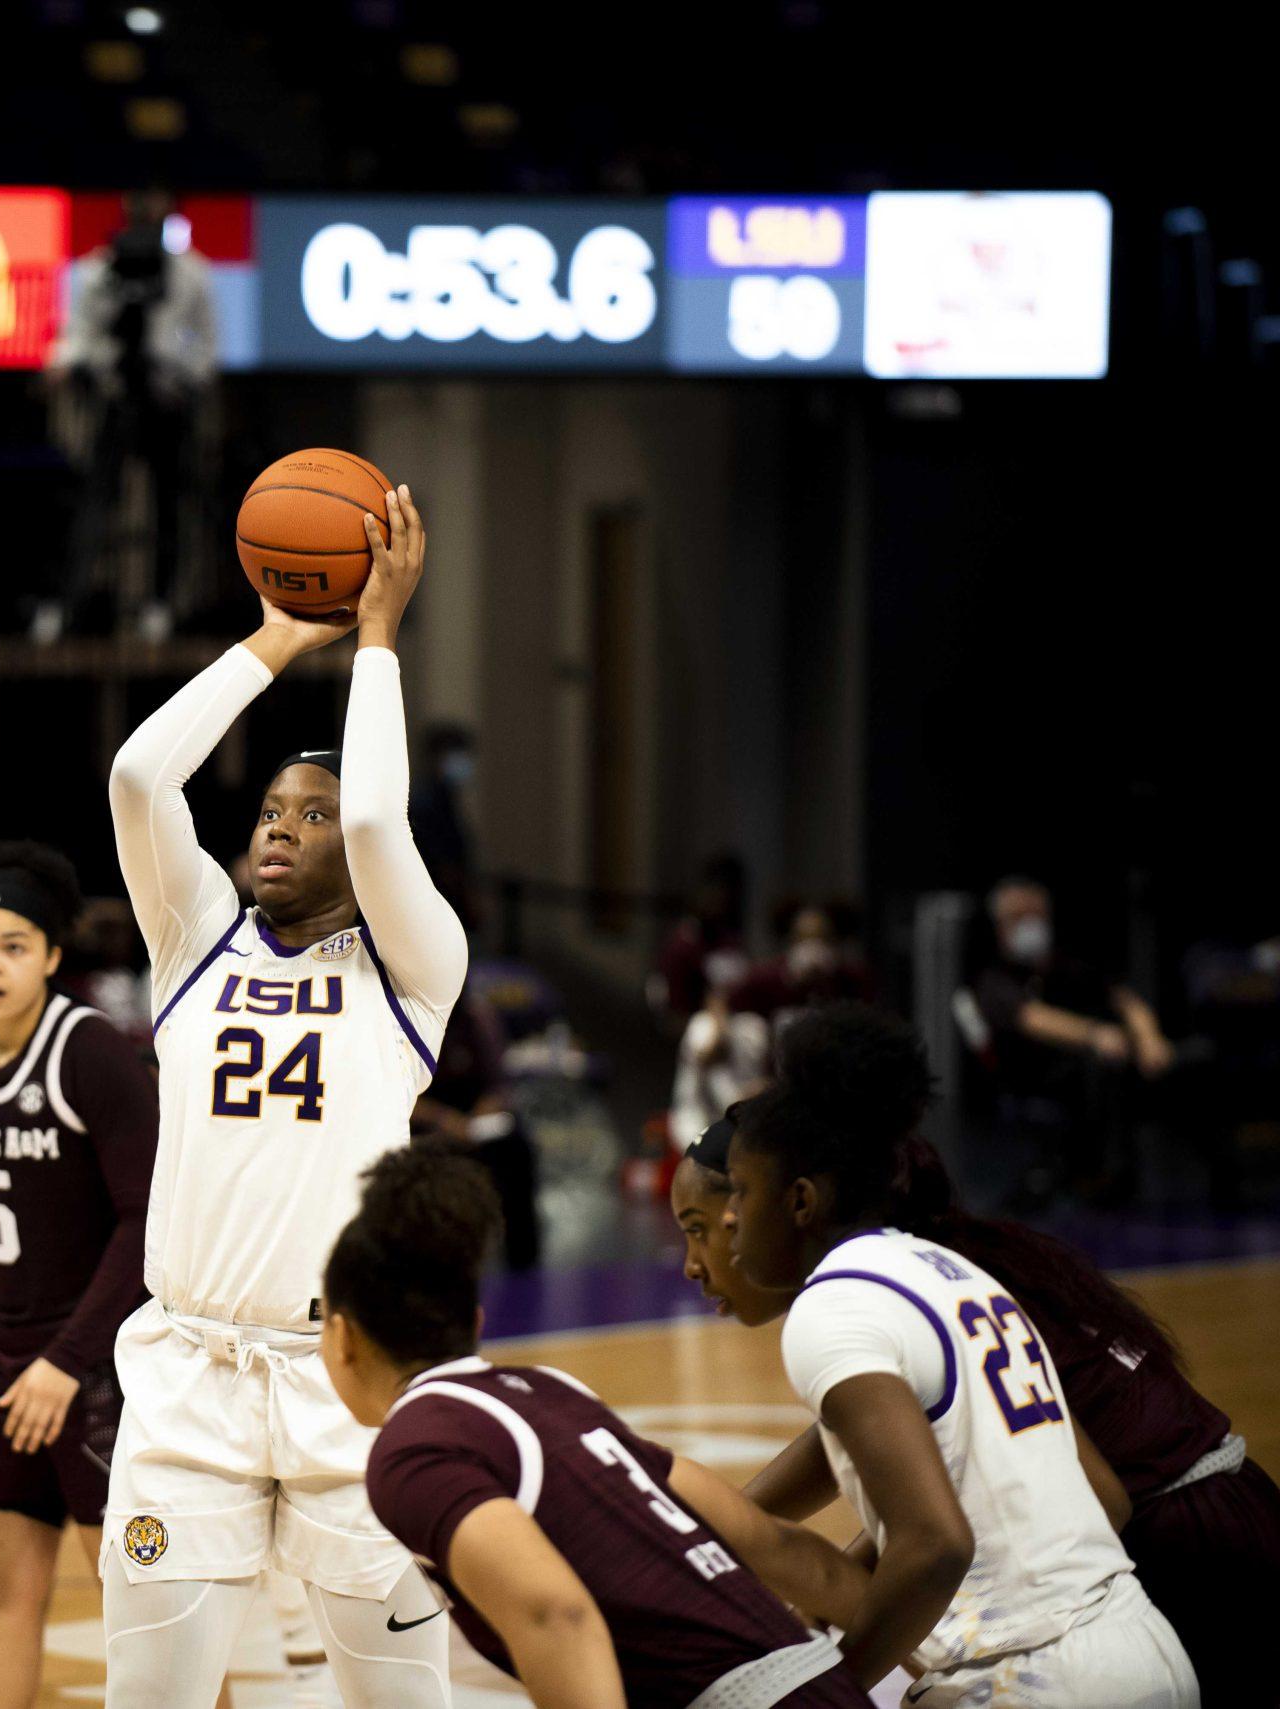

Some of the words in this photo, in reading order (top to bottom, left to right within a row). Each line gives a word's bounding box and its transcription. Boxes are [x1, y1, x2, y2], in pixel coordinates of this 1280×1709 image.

[300, 223, 657, 343] 0:53.6
[322, 933, 355, 954] SEC
[213, 973, 344, 1018] LSU
[210, 1026, 324, 1124] 24
[4, 1126, 60, 1161] A&M
[957, 1294, 1064, 1437] 23
[579, 1427, 698, 1534] 3
